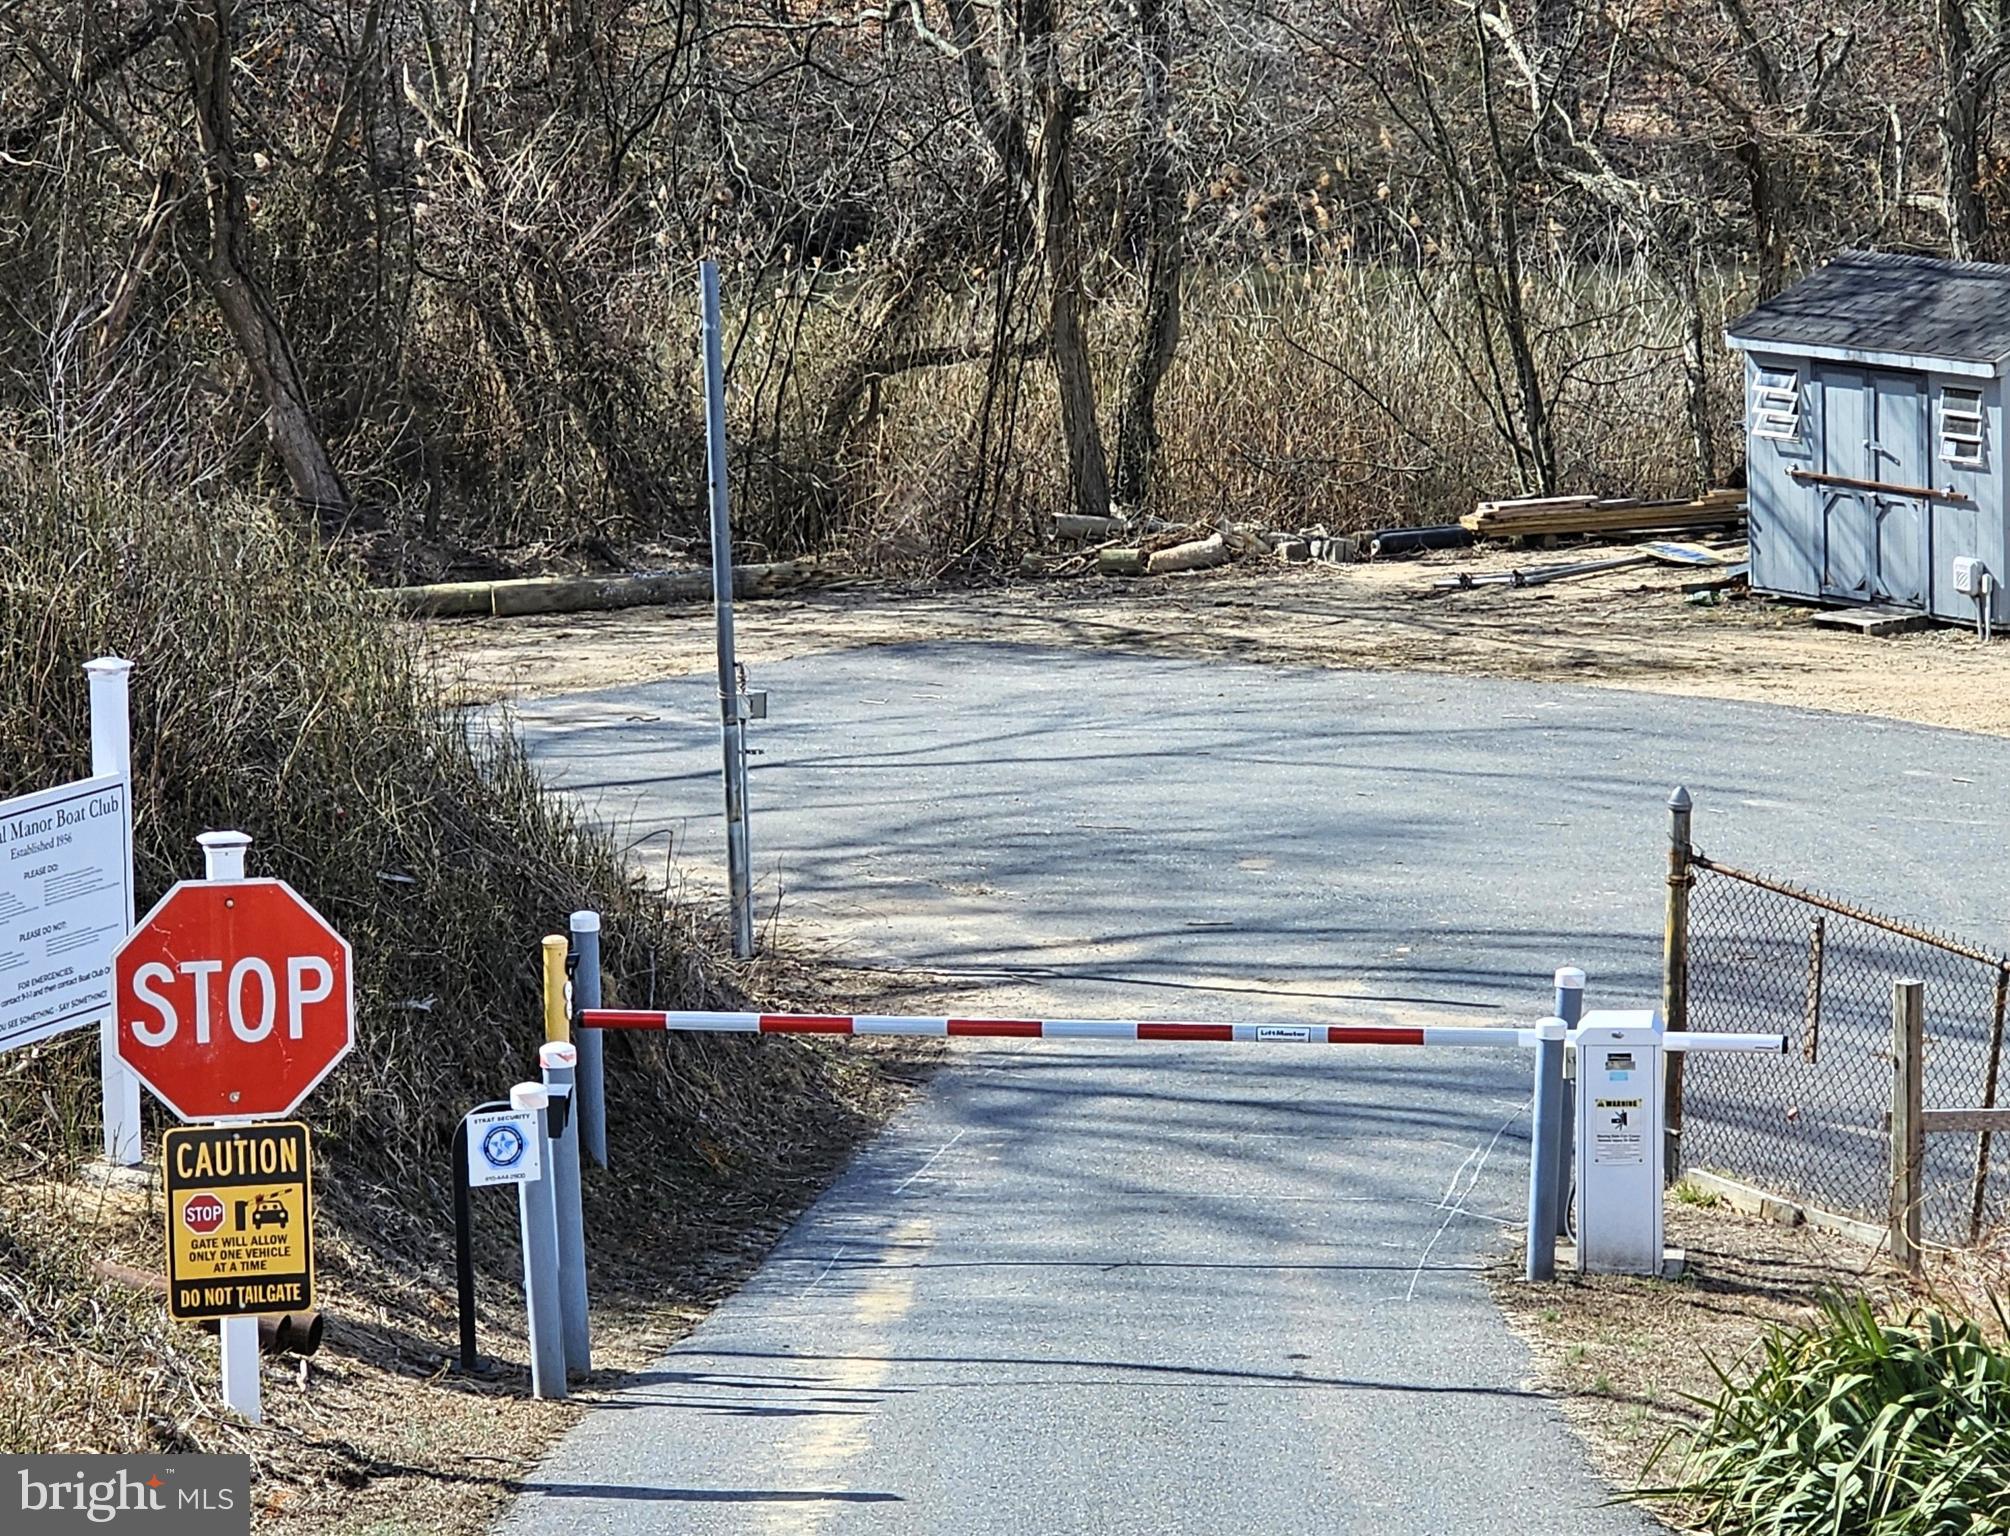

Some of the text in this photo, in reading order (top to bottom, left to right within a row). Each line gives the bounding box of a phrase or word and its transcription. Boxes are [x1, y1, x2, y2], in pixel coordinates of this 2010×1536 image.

[11, 818, 53, 841] Manor
[56, 808, 86, 828] Boat
[89, 795, 119, 818] Club
[10, 837, 54, 860] Established
[23, 865, 47, 880] PLEASE
[19, 927, 41, 943] PLEASE
[42, 924, 52, 936] DO
[17, 979, 30, 991] FOR
[57, 977, 78, 989] contact
[78, 972, 91, 983] Boat
[131, 957, 334, 1047] STOP
[7, 1017, 19, 1030] SEE
[19, 1006, 55, 1025] SOMETHING
[58, 1001, 71, 1013] SAY
[1605, 1100, 1637, 1108] WARNING
[497, 1113, 530, 1122] SECURITY
[176, 1137, 298, 1179] CAUTION
[186, 1205, 223, 1223] STOP
[191, 1234, 288, 1250] GATE WILL ALLOW
[189, 1246, 291, 1263] ONLY ONE VEHICLE
[213, 1260, 267, 1273] AT A TIME
[180, 1283, 302, 1308] DO NOT TAILGATE
